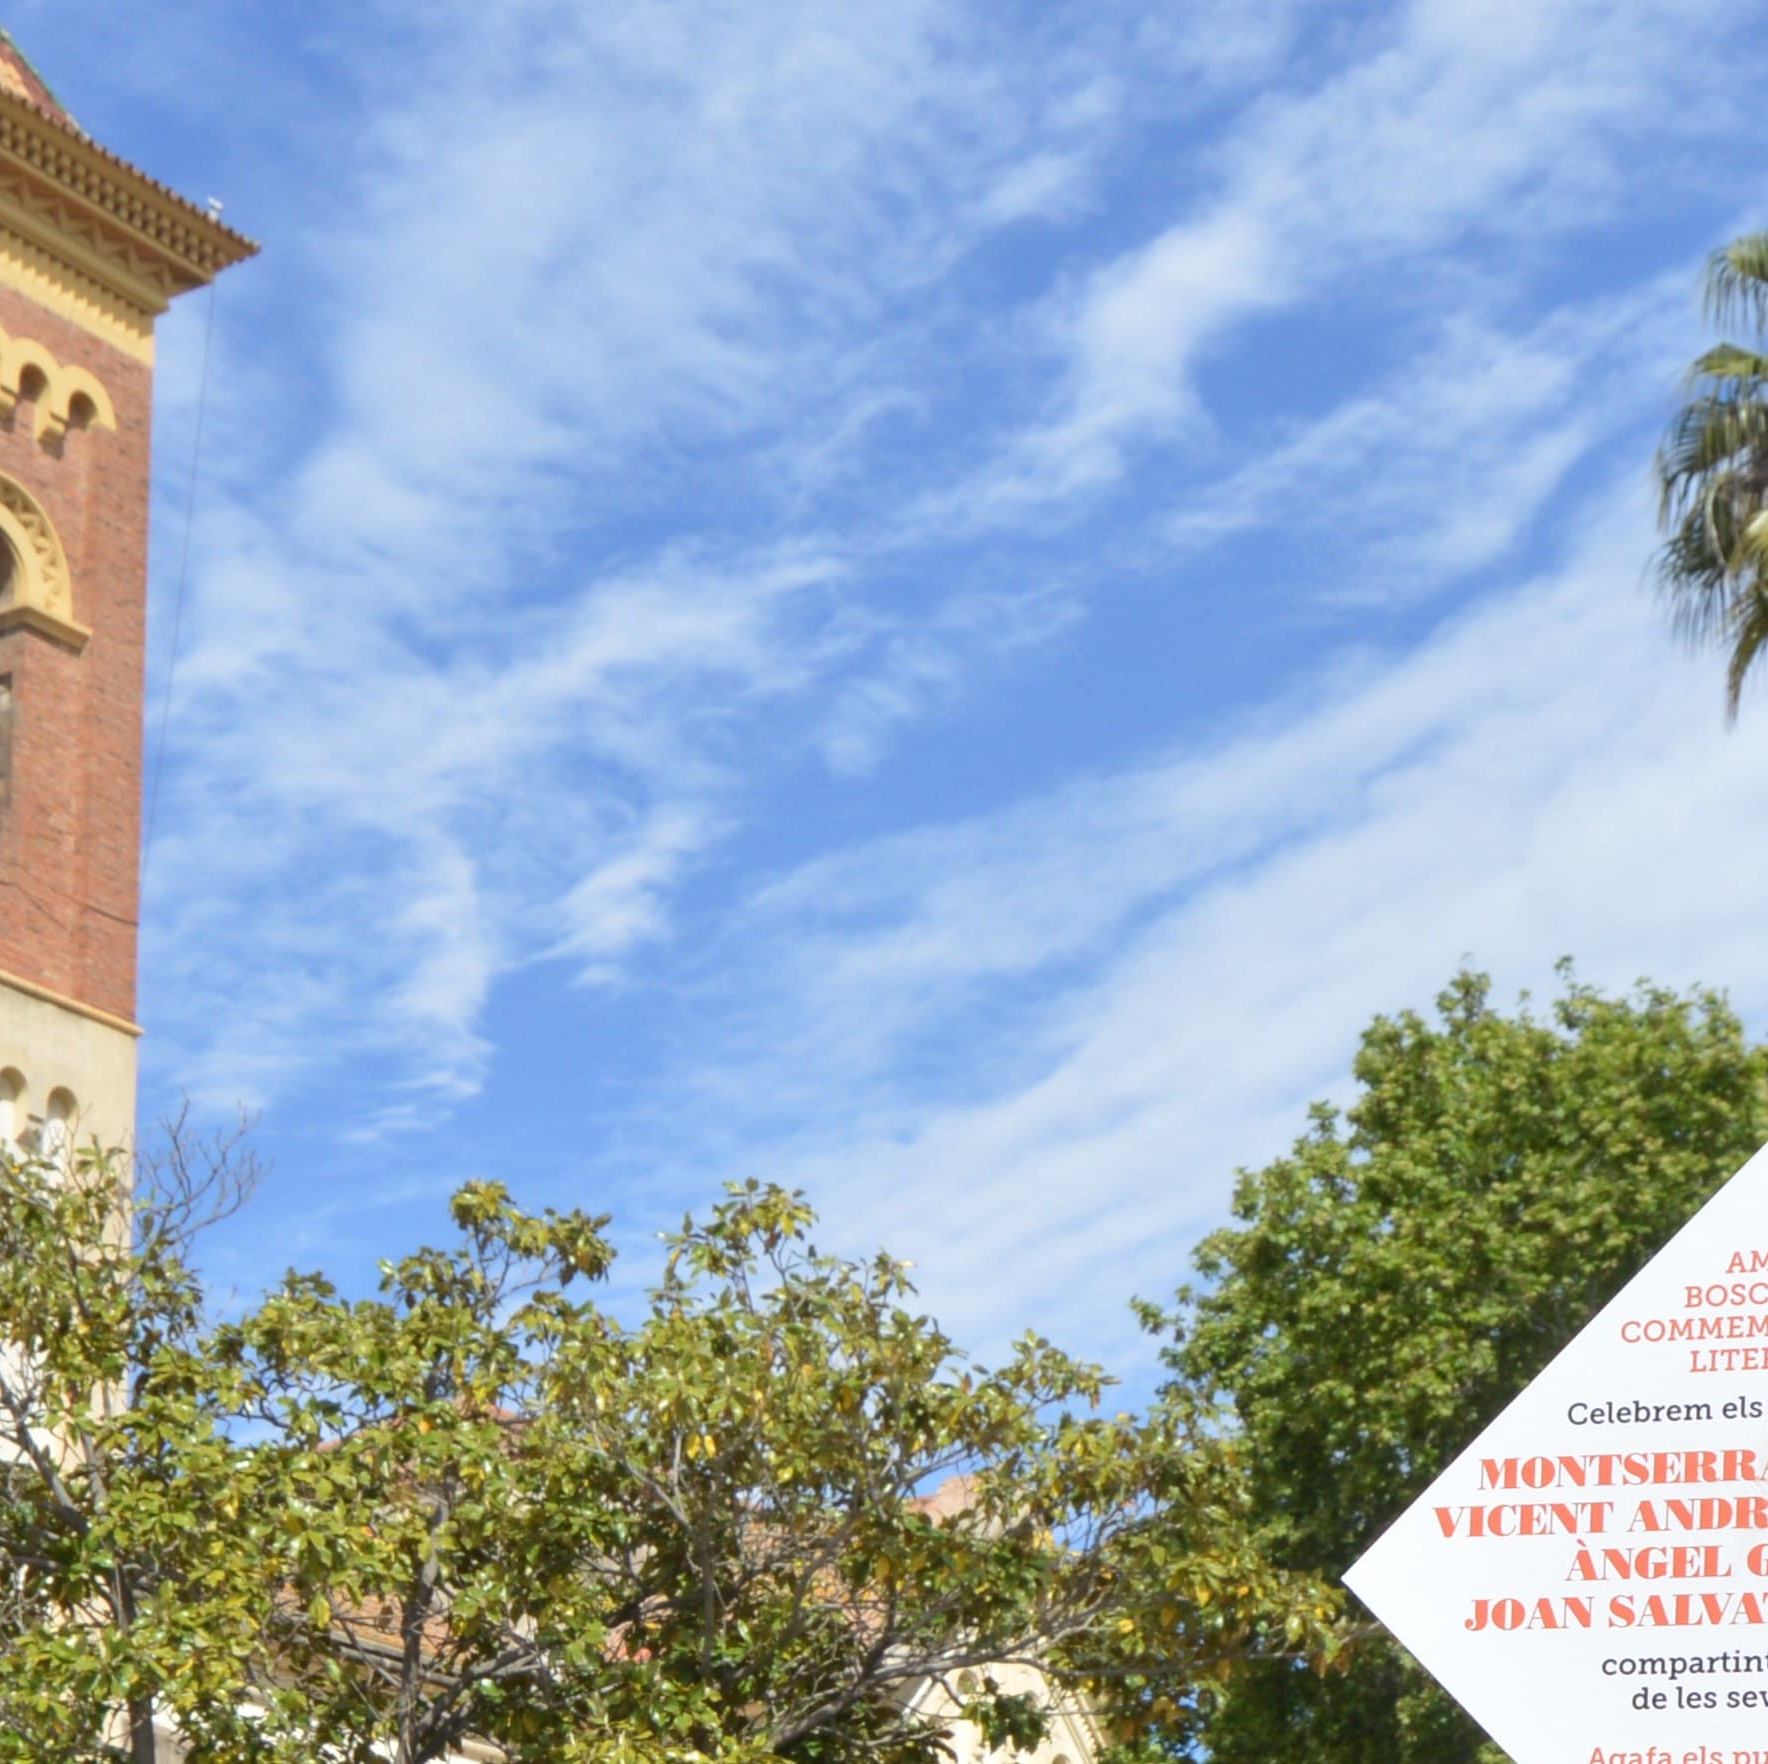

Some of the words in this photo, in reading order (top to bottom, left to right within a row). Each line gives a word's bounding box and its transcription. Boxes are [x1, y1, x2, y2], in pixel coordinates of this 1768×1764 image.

[1685, 1283, 1768, 1307] BOSC
[1568, 1401, 1712, 1425] Celebrem
[1722, 1396, 1762, 1419] els
[1434, 1502, 1613, 1537] VICENT
[1567, 1539, 1731, 1581] ÀNGEL
[1465, 1597, 1592, 1631] JOAN
[1632, 1687, 1667, 1710] de
[1676, 1686, 1717, 1709] les
